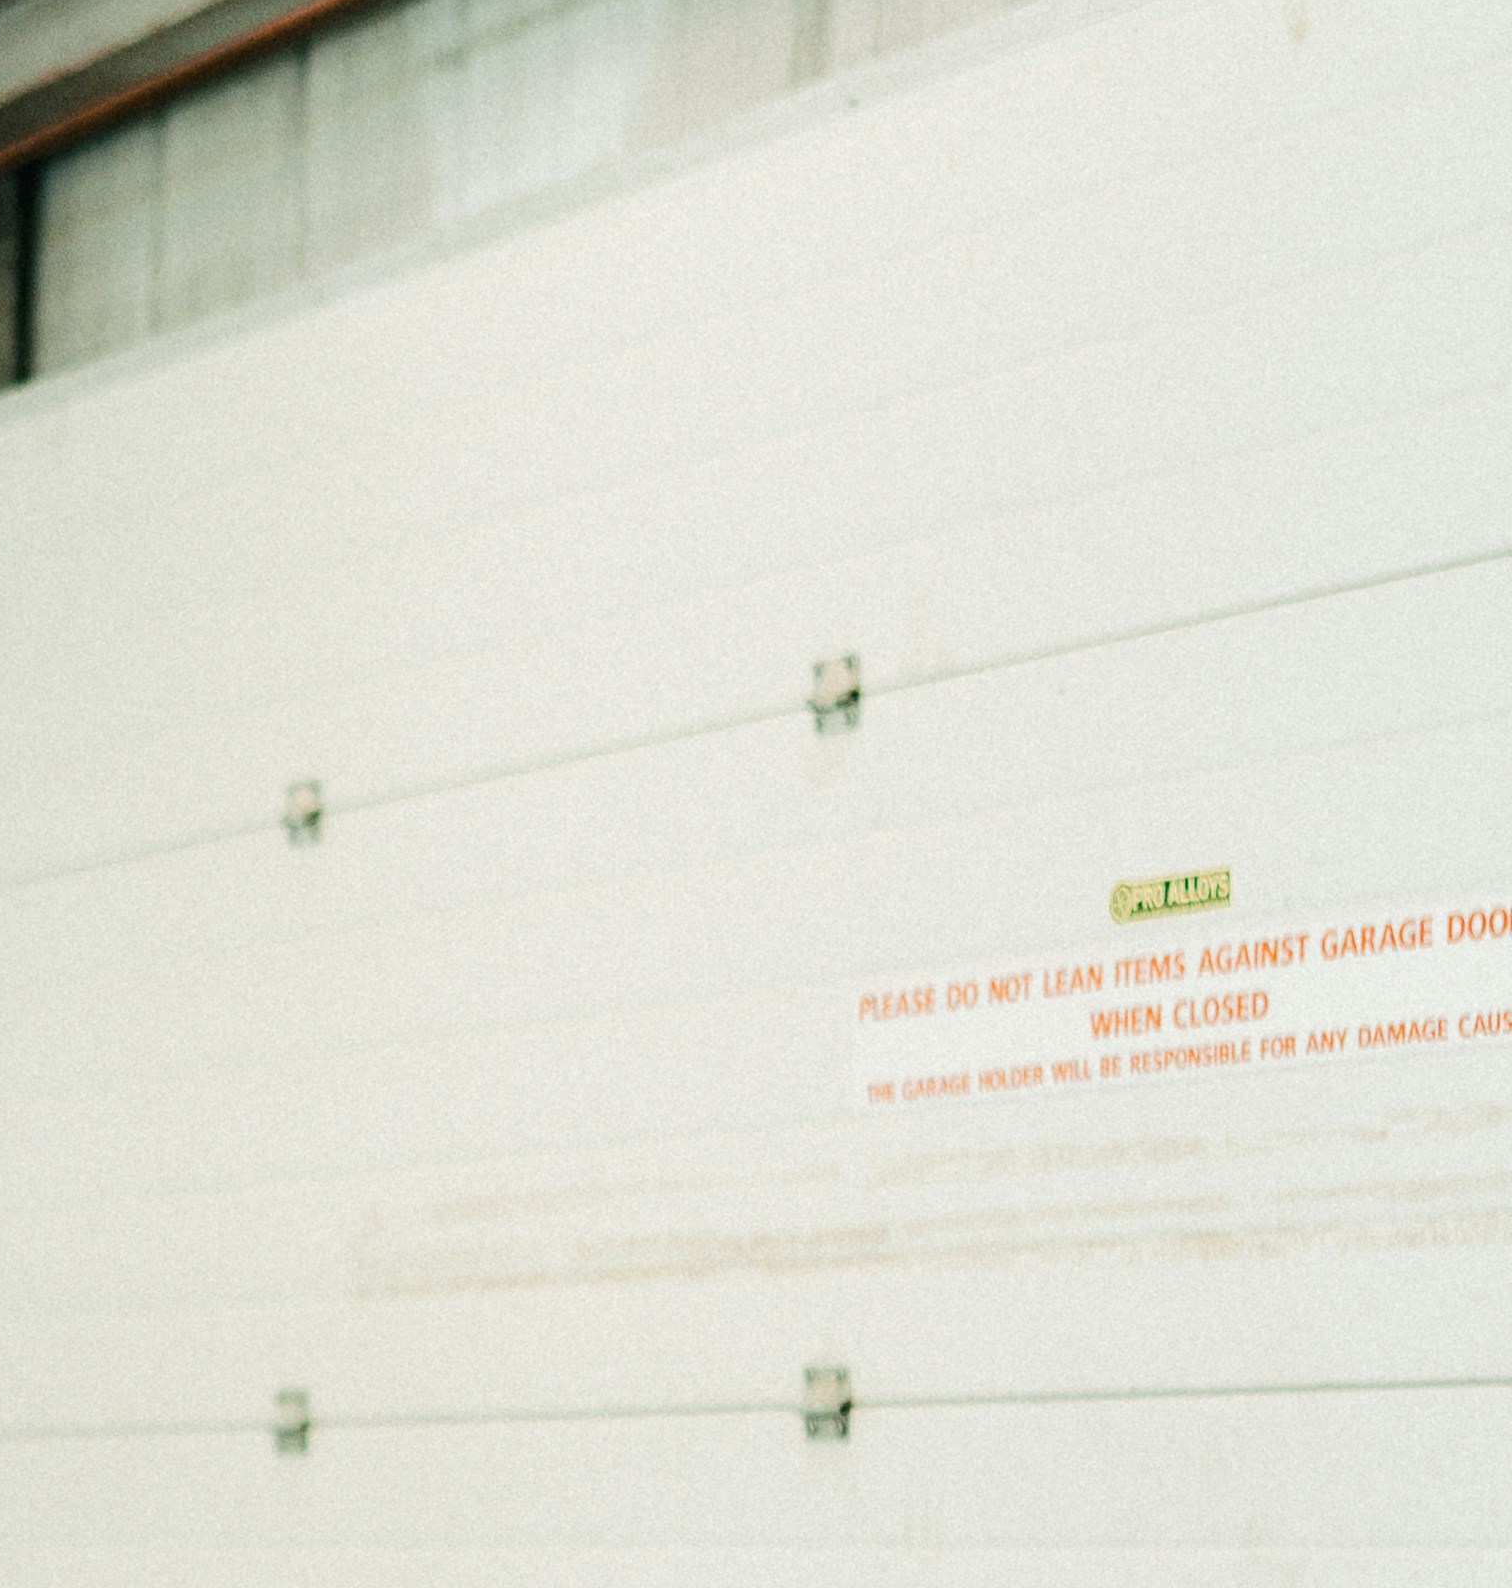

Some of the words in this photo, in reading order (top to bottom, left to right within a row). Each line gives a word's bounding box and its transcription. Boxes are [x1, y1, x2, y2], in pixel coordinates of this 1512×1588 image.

[1132, 883, 1166, 911] PRO
[1168, 872, 1230, 906] ALLOYS
[859, 983, 936, 1023] PLEASE
[945, 980, 979, 1011] DO
[988, 972, 1033, 1004] NOT
[1042, 964, 1104, 998] LEAN
[1114, 949, 1185, 988] ITEMS
[1198, 933, 1309, 978] AGAINST
[1320, 915, 1433, 961] GARAGE
[1090, 1003, 1163, 1040] WHEN
[1173, 990, 1270, 1030] CLOSED
[867, 1079, 895, 1104] THE
[901, 1071, 970, 1101] GARAGE
[977, 1062, 1044, 1092] HOLDER
[1051, 1058, 1092, 1085] WILL
[1099, 1054, 1122, 1078] BE
[1130, 1039, 1252, 1076] RESPONSIBLE
[1260, 1034, 1297, 1062] FOR
[1305, 1026, 1348, 1055] ANY
[1358, 1015, 1449, 1050] DAMAGE
